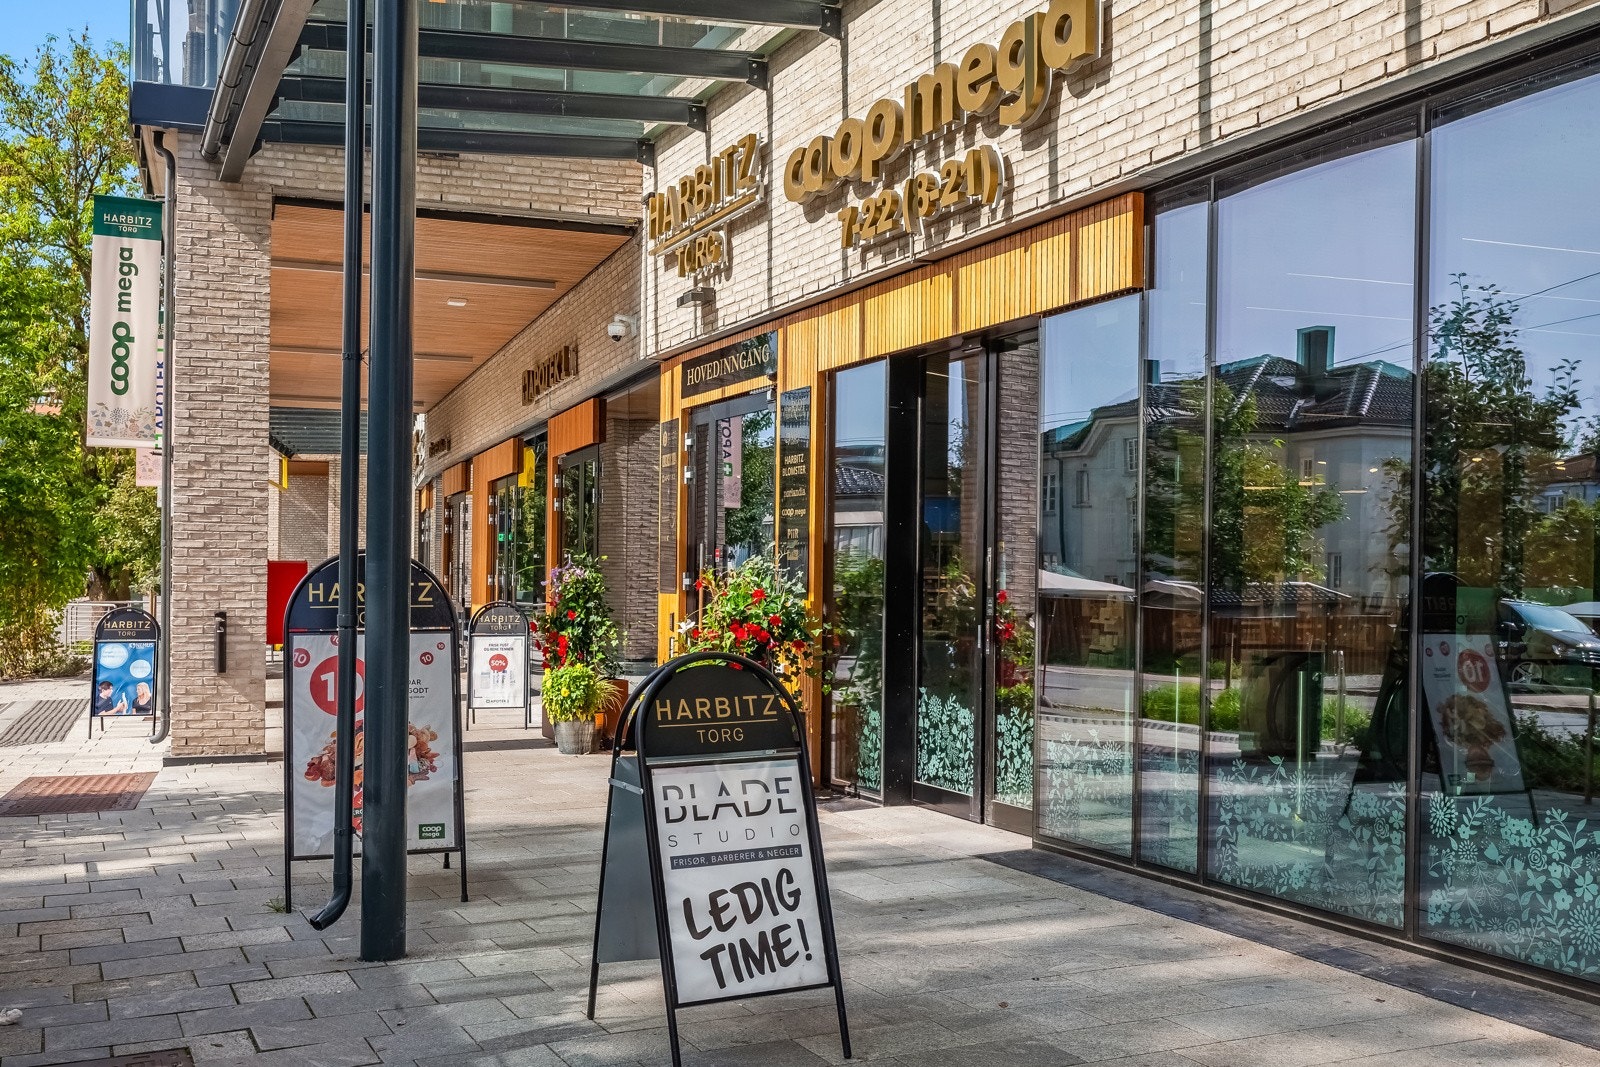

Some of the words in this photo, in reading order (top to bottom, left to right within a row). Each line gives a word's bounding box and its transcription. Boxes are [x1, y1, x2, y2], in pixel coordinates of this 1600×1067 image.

[784, 99, 904, 203] coop
[904, 0, 1098, 143] mega
[648, 133, 758, 240] HARBITZ
[838, 189, 902, 248] 7-22
[903, 144, 1002, 233] (8-21)
[103, 213, 152, 226] HARBITZ
[118, 225, 138, 233] TORG
[675, 230, 723, 278] TORG
[117, 246, 139, 313] mega
[110, 321, 135, 396] coop
[686, 343, 770, 387] HOVEDINNGANG
[782, 465, 806, 477] BLOMSTER
[784, 454, 804, 465] HARBITZ
[781, 508, 794, 518] coop
[794, 508, 806, 517] mega
[308, 582, 433, 602] HARZ
[421, 654, 432, 663] 10
[655, 694, 778, 721] HARBITZ
[697, 727, 744, 744] TORG
[662, 776, 798, 824] BLADE
[667, 823, 801, 848] STUDIO
[673, 856, 709, 867] FRISØR,
[711, 849, 756, 863] BARBERER
[758, 850, 765, 859] &
[766, 847, 800, 858] NEGLER
[682, 867, 802, 940] LEDIG
[699, 918, 813, 990] TIME!
